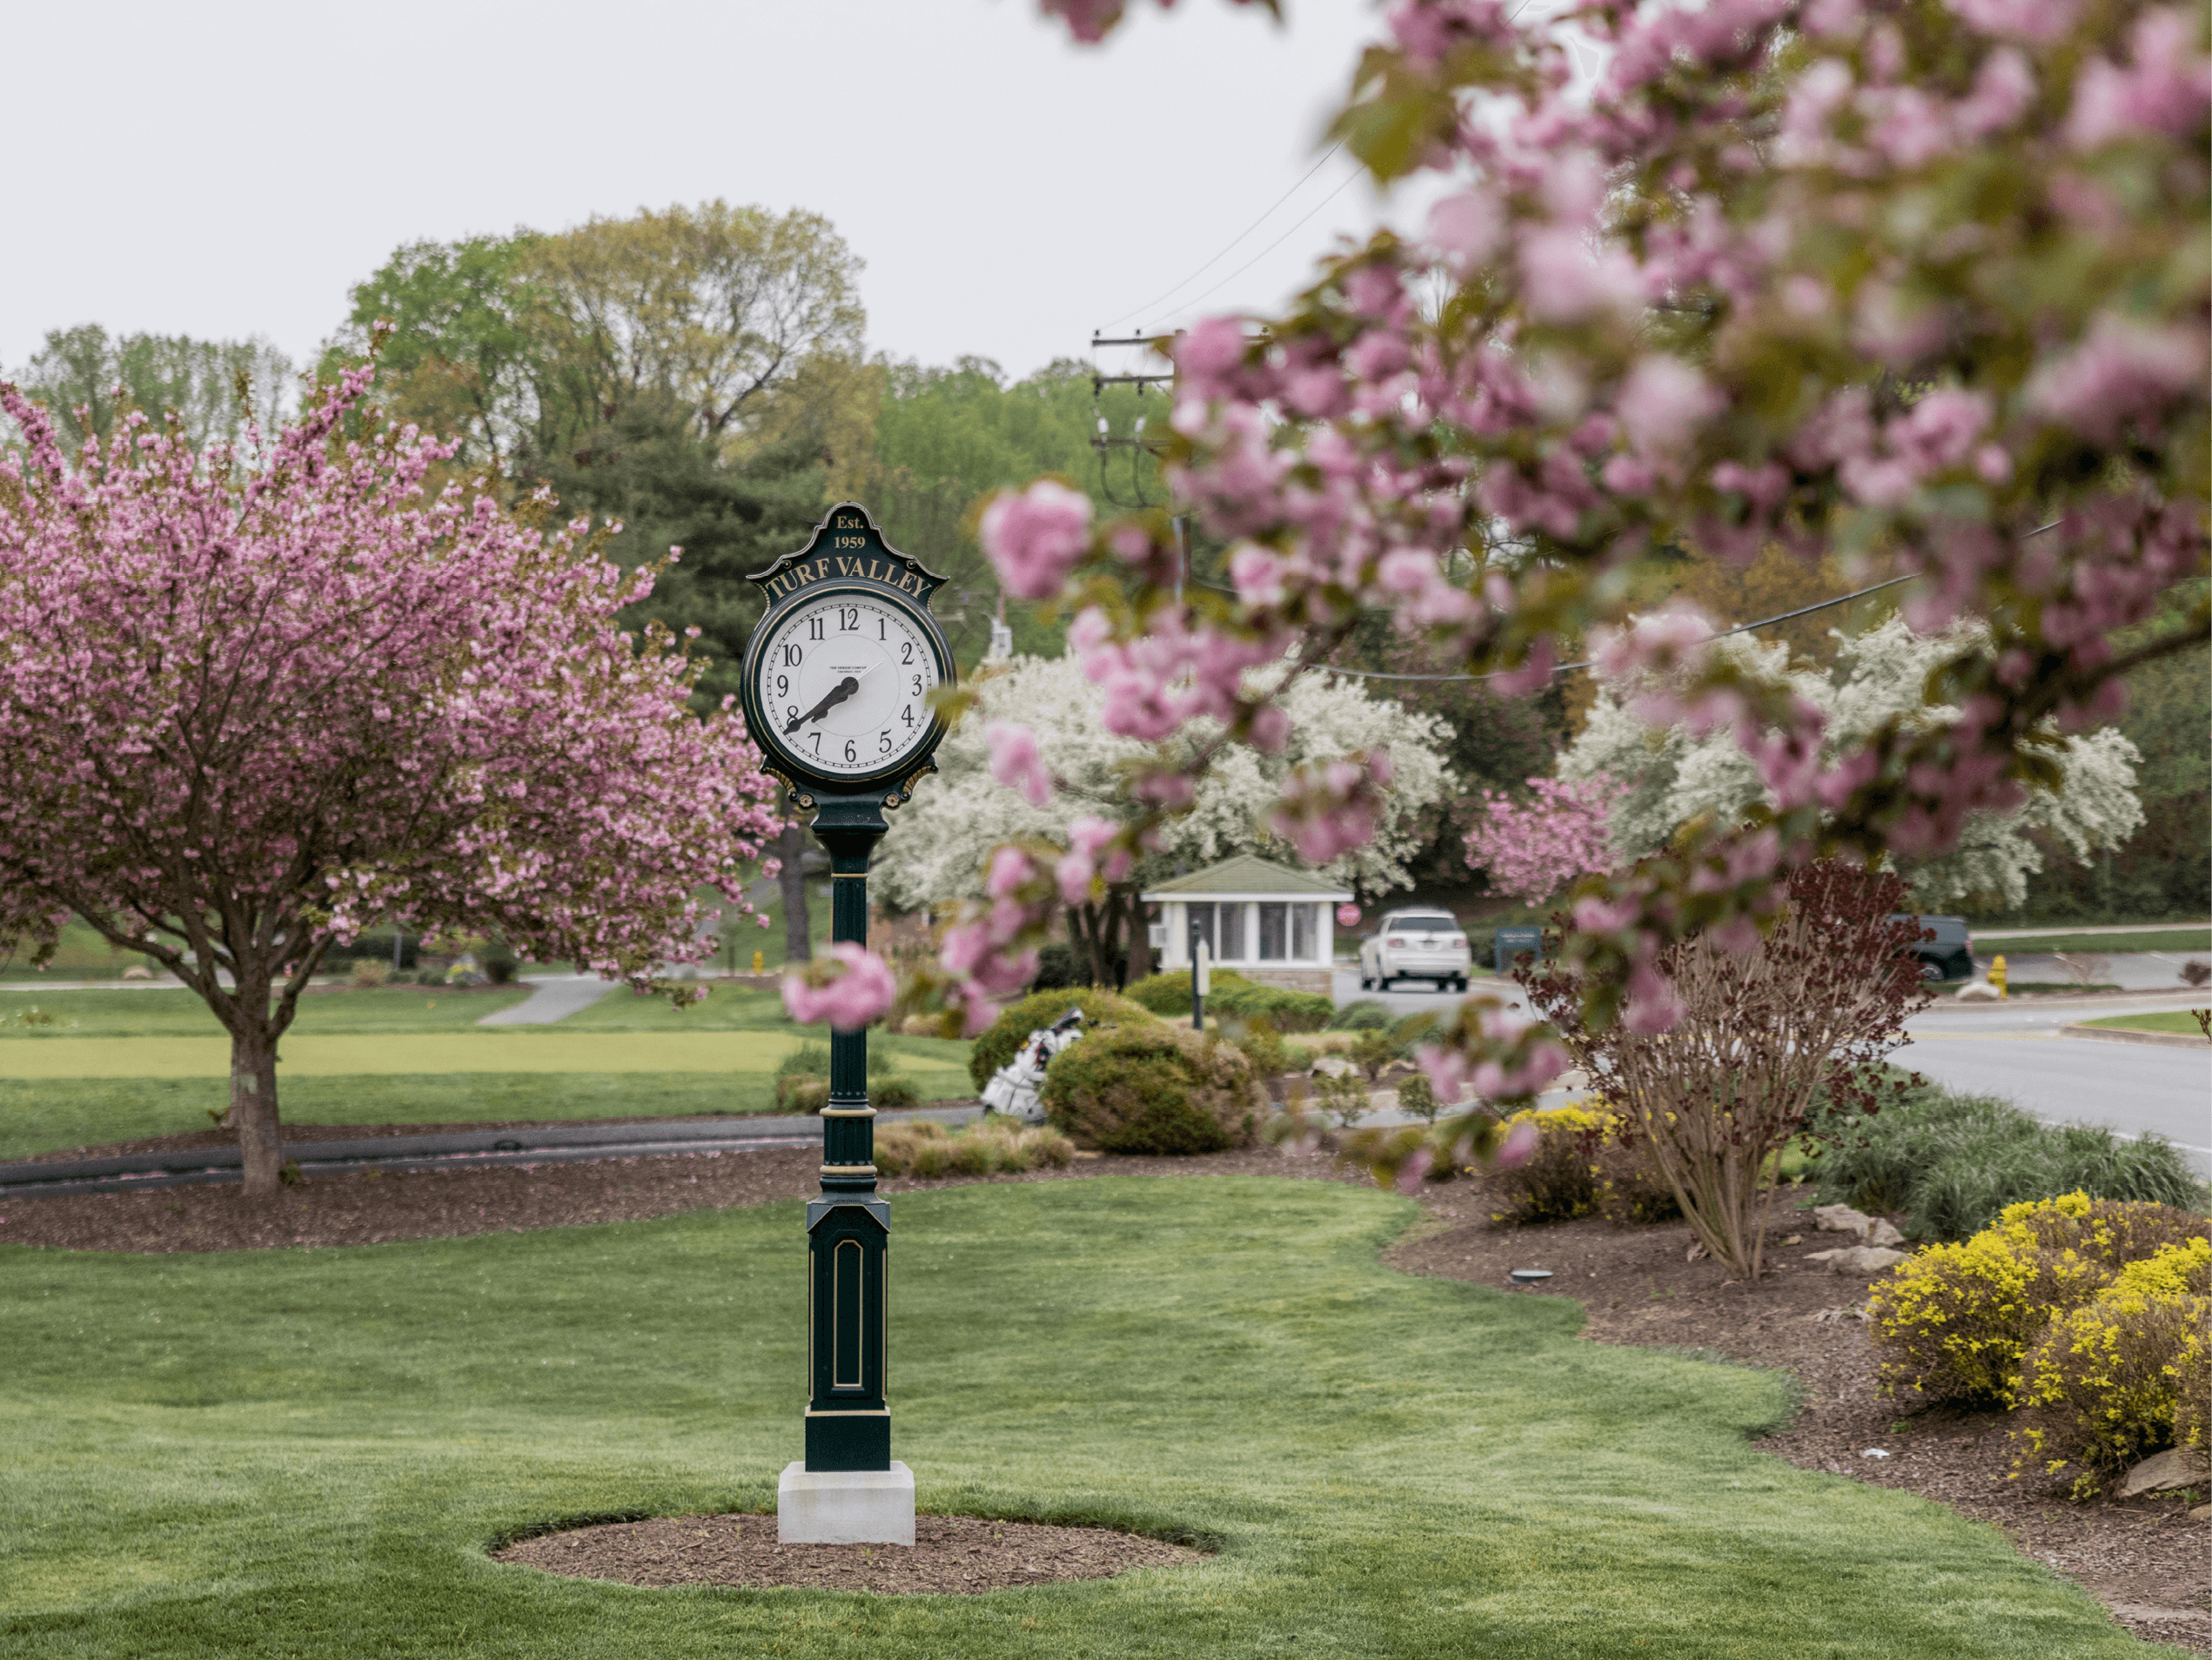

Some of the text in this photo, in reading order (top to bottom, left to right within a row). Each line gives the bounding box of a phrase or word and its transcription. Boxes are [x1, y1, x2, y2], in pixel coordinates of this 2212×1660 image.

[836, 515, 864, 529] Est.
[835, 536, 866, 549] 1959
[765, 556, 932, 599] TURF VALLEY
[808, 618, 826, 640] 11
[839, 608, 861, 631] 12
[878, 618, 887, 641] 1
[782, 644, 802, 667] 10
[901, 641, 915, 666] 2
[777, 674, 789, 698] 9
[911, 674, 922, 697] 3
[787, 705, 799, 727] 8
[901, 704, 915, 728] 4
[808, 732, 822, 756] 7
[844, 740, 857, 763] 6
[879, 729, 892, 753] 5
